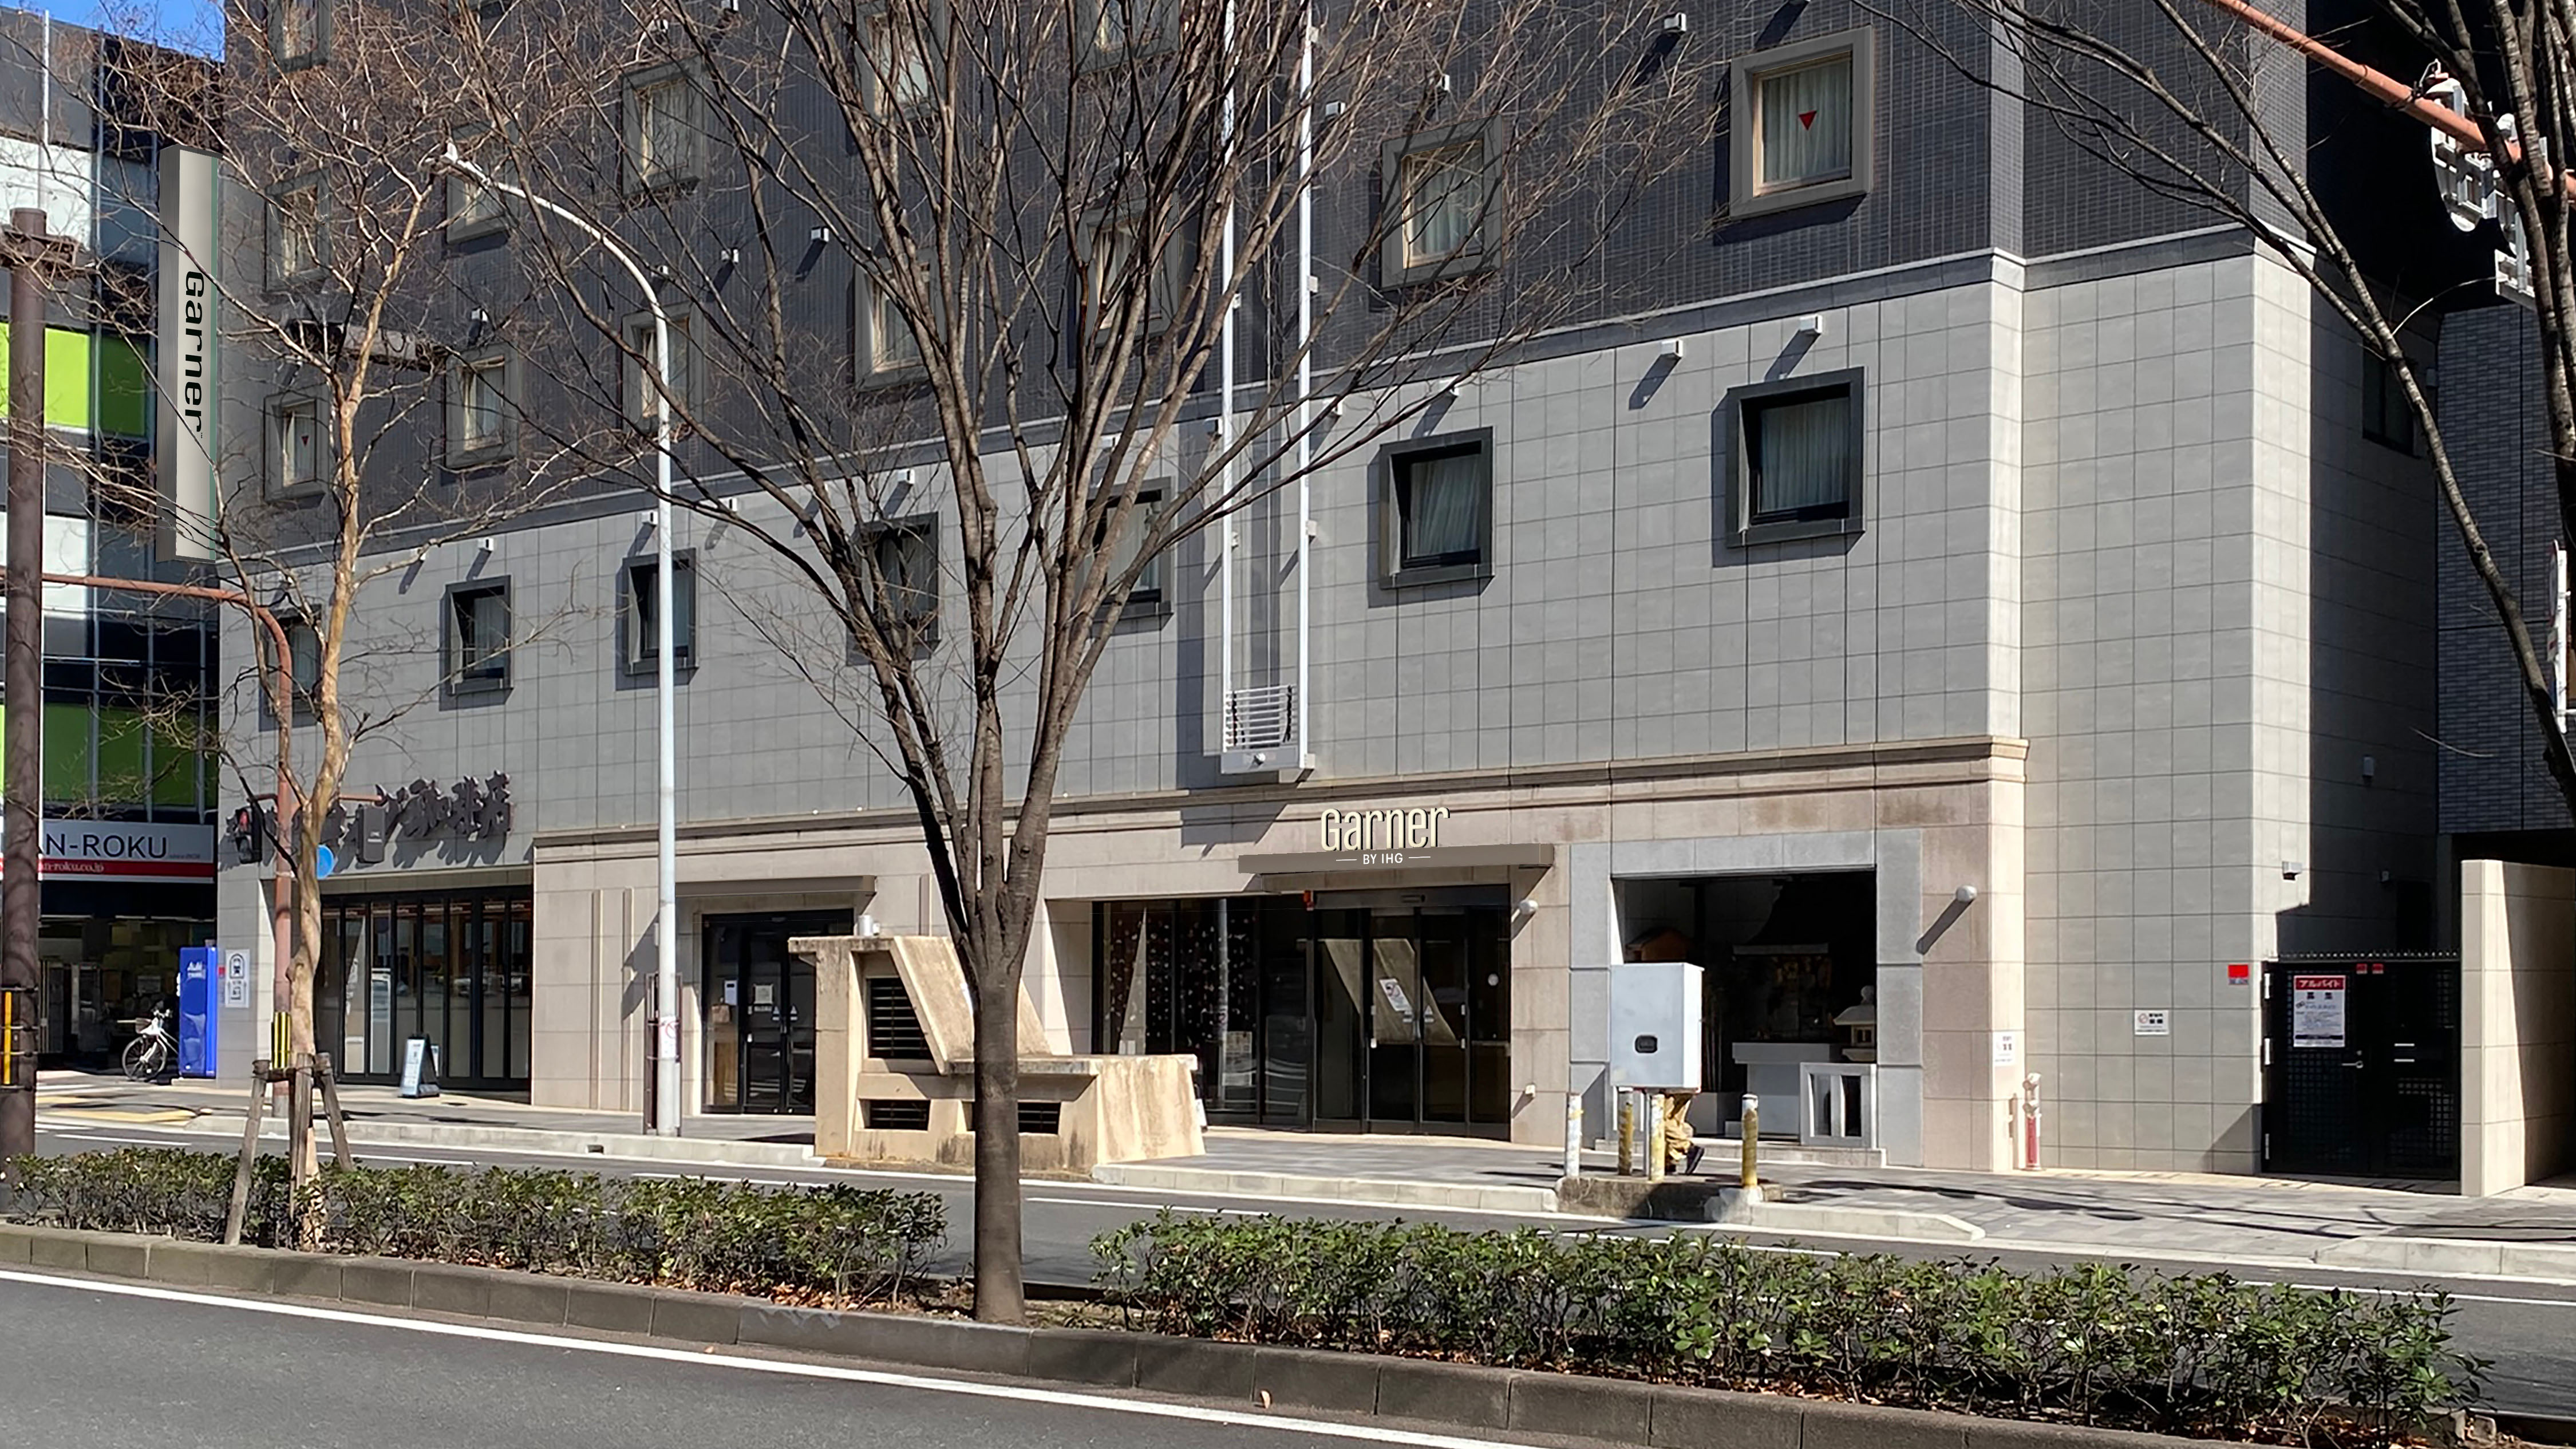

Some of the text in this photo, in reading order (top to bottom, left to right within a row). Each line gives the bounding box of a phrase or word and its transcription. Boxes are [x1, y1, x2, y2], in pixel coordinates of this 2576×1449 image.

[185, 271, 204, 432] Garner
[1321, 807, 1451, 851] Garner
[38, 833, 167, 859] N-ROKU
[1363, 852, 1403, 864] BY IHG
[39, 860, 104, 873] n-roku.co.jp
